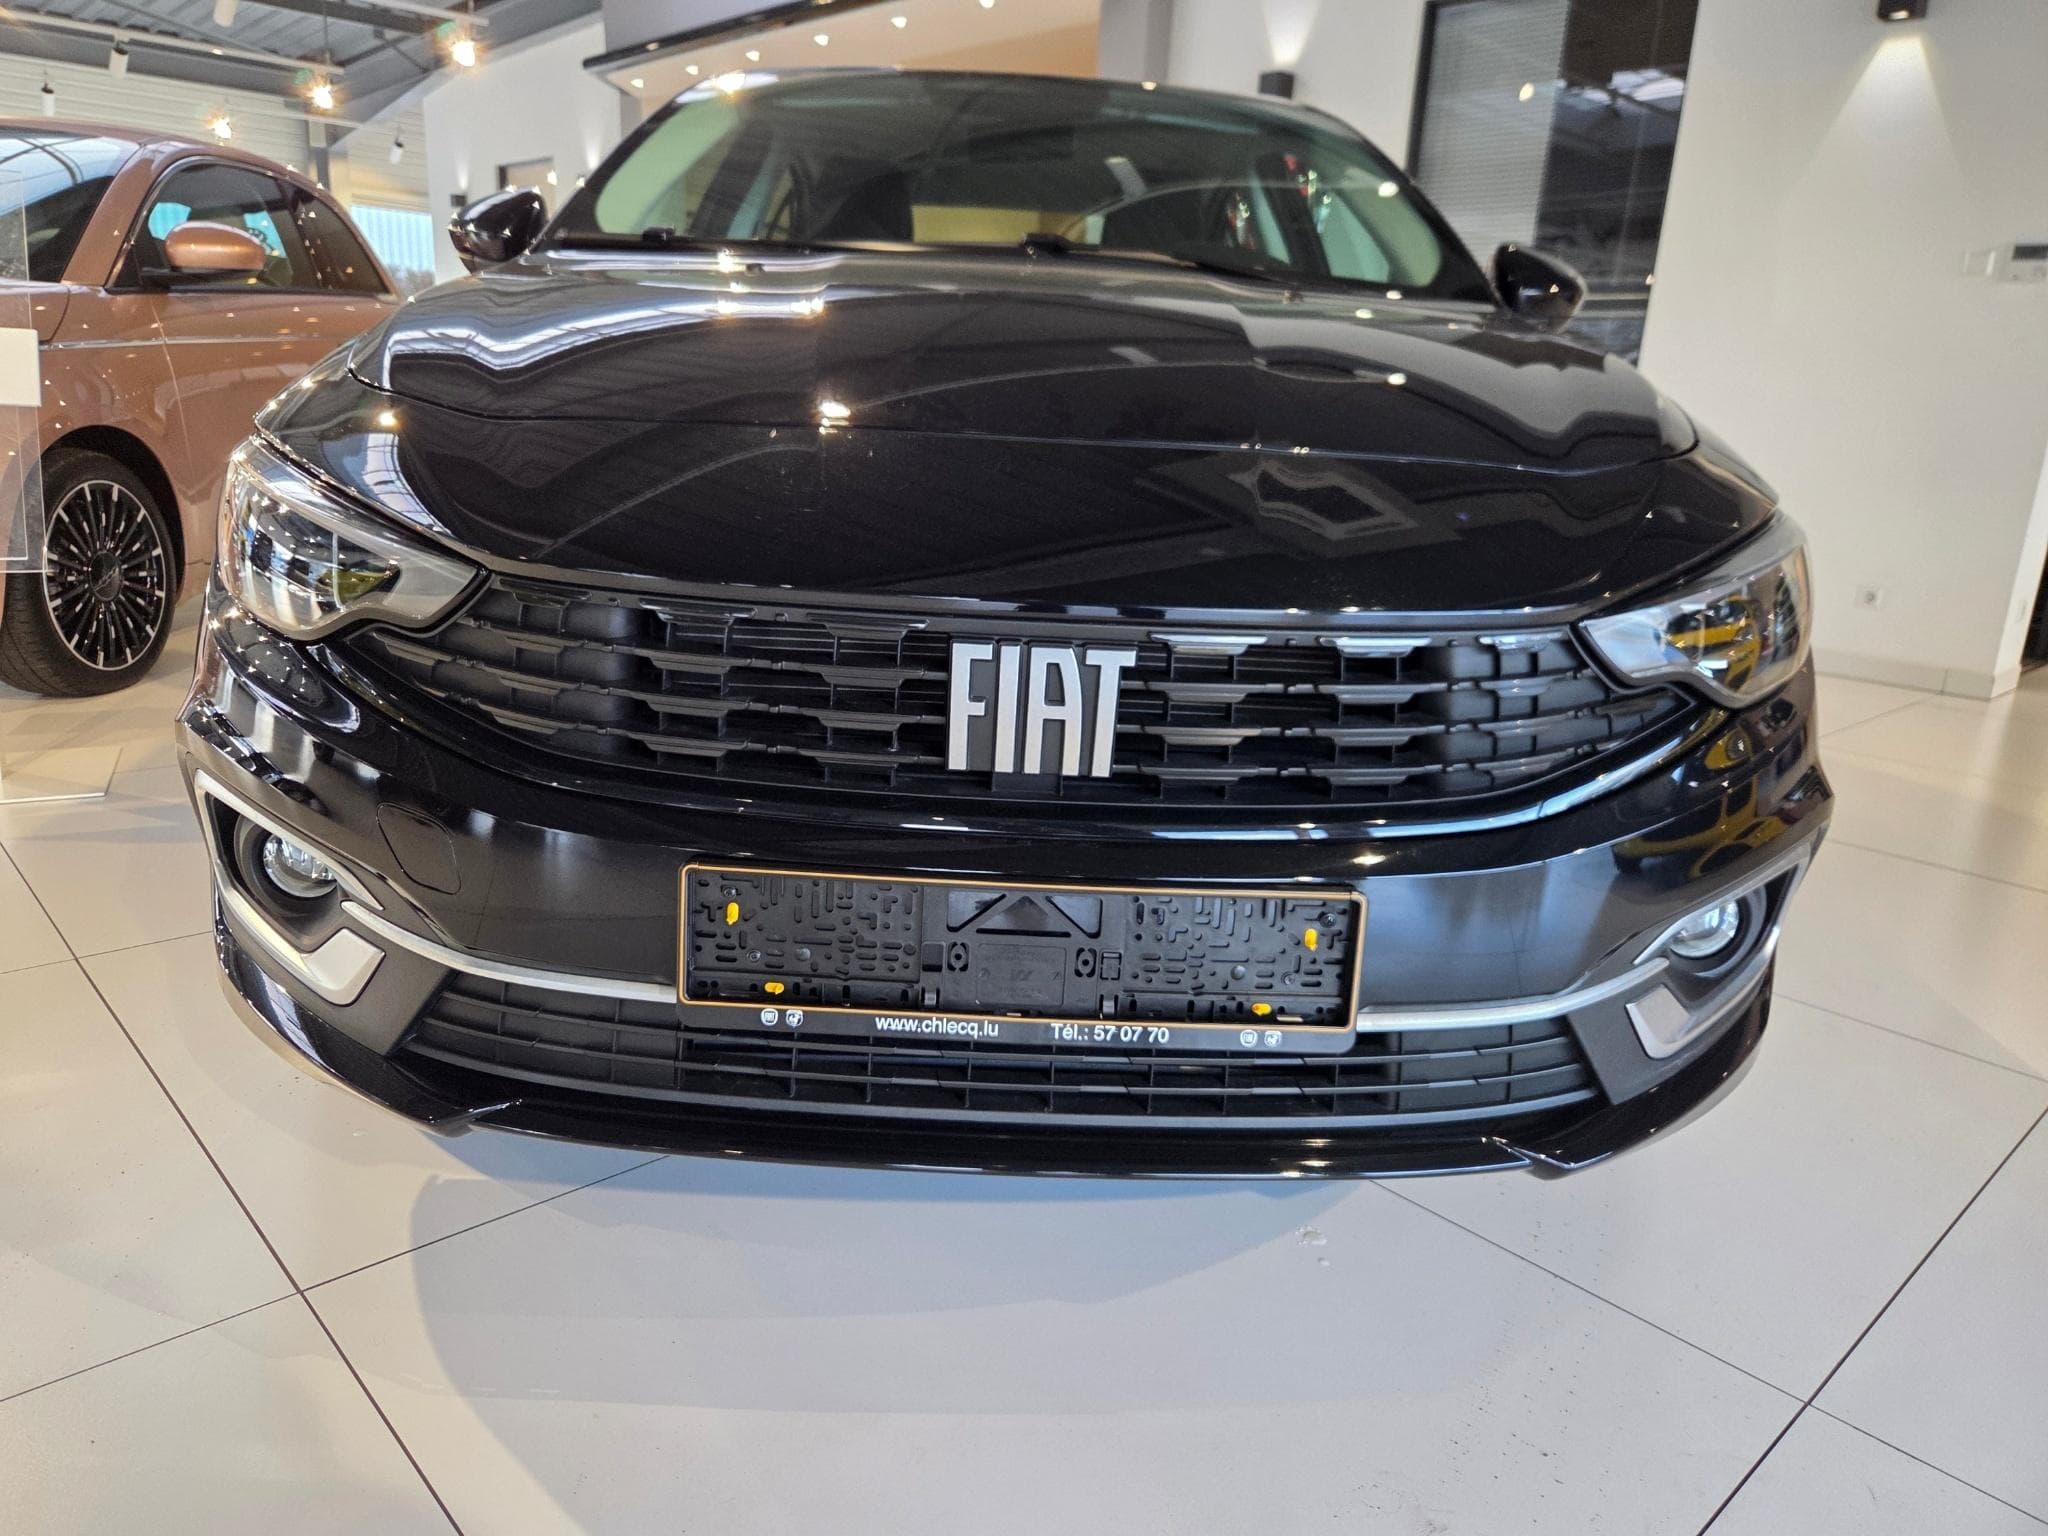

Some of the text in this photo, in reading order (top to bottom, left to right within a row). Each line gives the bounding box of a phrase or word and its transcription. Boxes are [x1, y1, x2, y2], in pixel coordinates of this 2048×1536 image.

[948, 642, 1137, 777] FIAT
[875, 1016, 999, 1039] www.chlecq.lu
[1051, 1023, 1170, 1044] Tél.: 57 07 70
